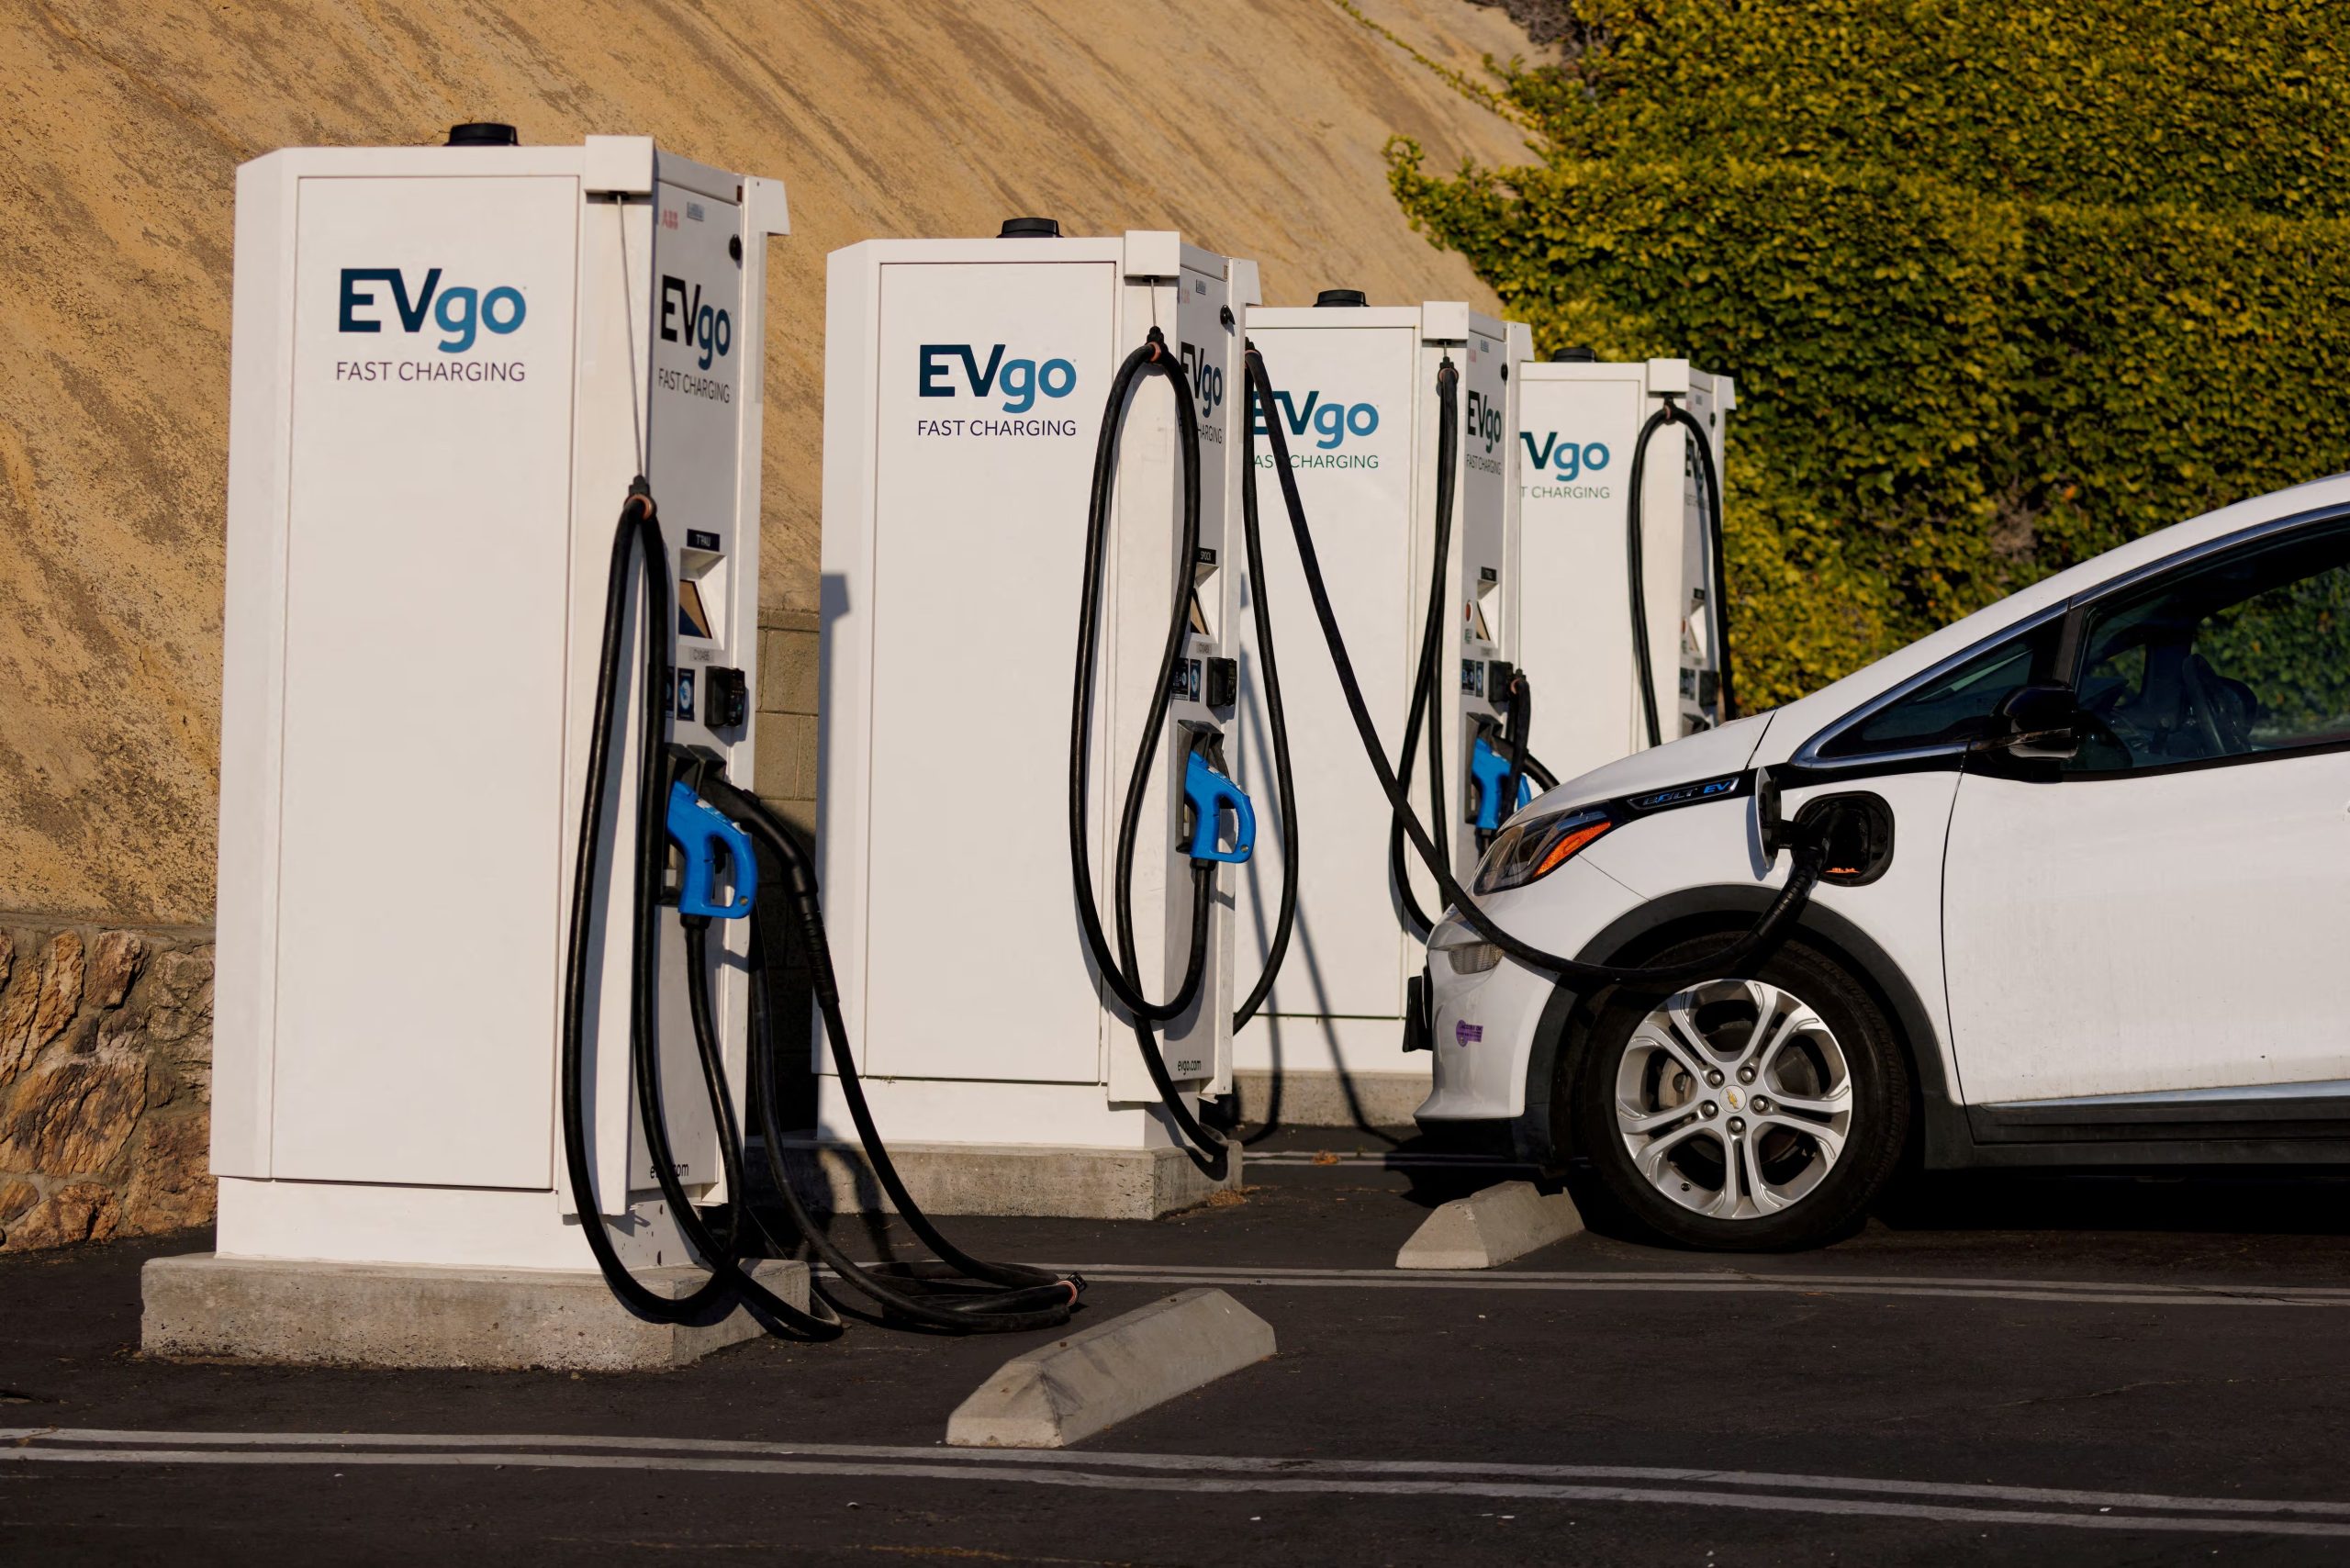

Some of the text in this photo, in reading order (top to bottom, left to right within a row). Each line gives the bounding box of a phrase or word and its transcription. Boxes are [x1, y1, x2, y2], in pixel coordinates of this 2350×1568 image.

[339, 268, 526, 353] EVgo
[661, 274, 731, 371] EVgo
[336, 362, 526, 381] FAST CHARGING
[919, 344, 1077, 413] EVgo
[658, 368, 730, 404] FAST CHARGING
[918, 420, 1076, 436] FAST CHARGING
[1197, 421, 1223, 444] HARGING
[1467, 389, 1502, 454] EVgo
[1290, 454, 1379, 469] CHARGING
[1519, 431, 1610, 482] Vgo
[1531, 486, 1610, 498] CHARGING
[1703, 781, 1731, 794] EV
[1177, 1059, 1202, 1075] evgo.com
